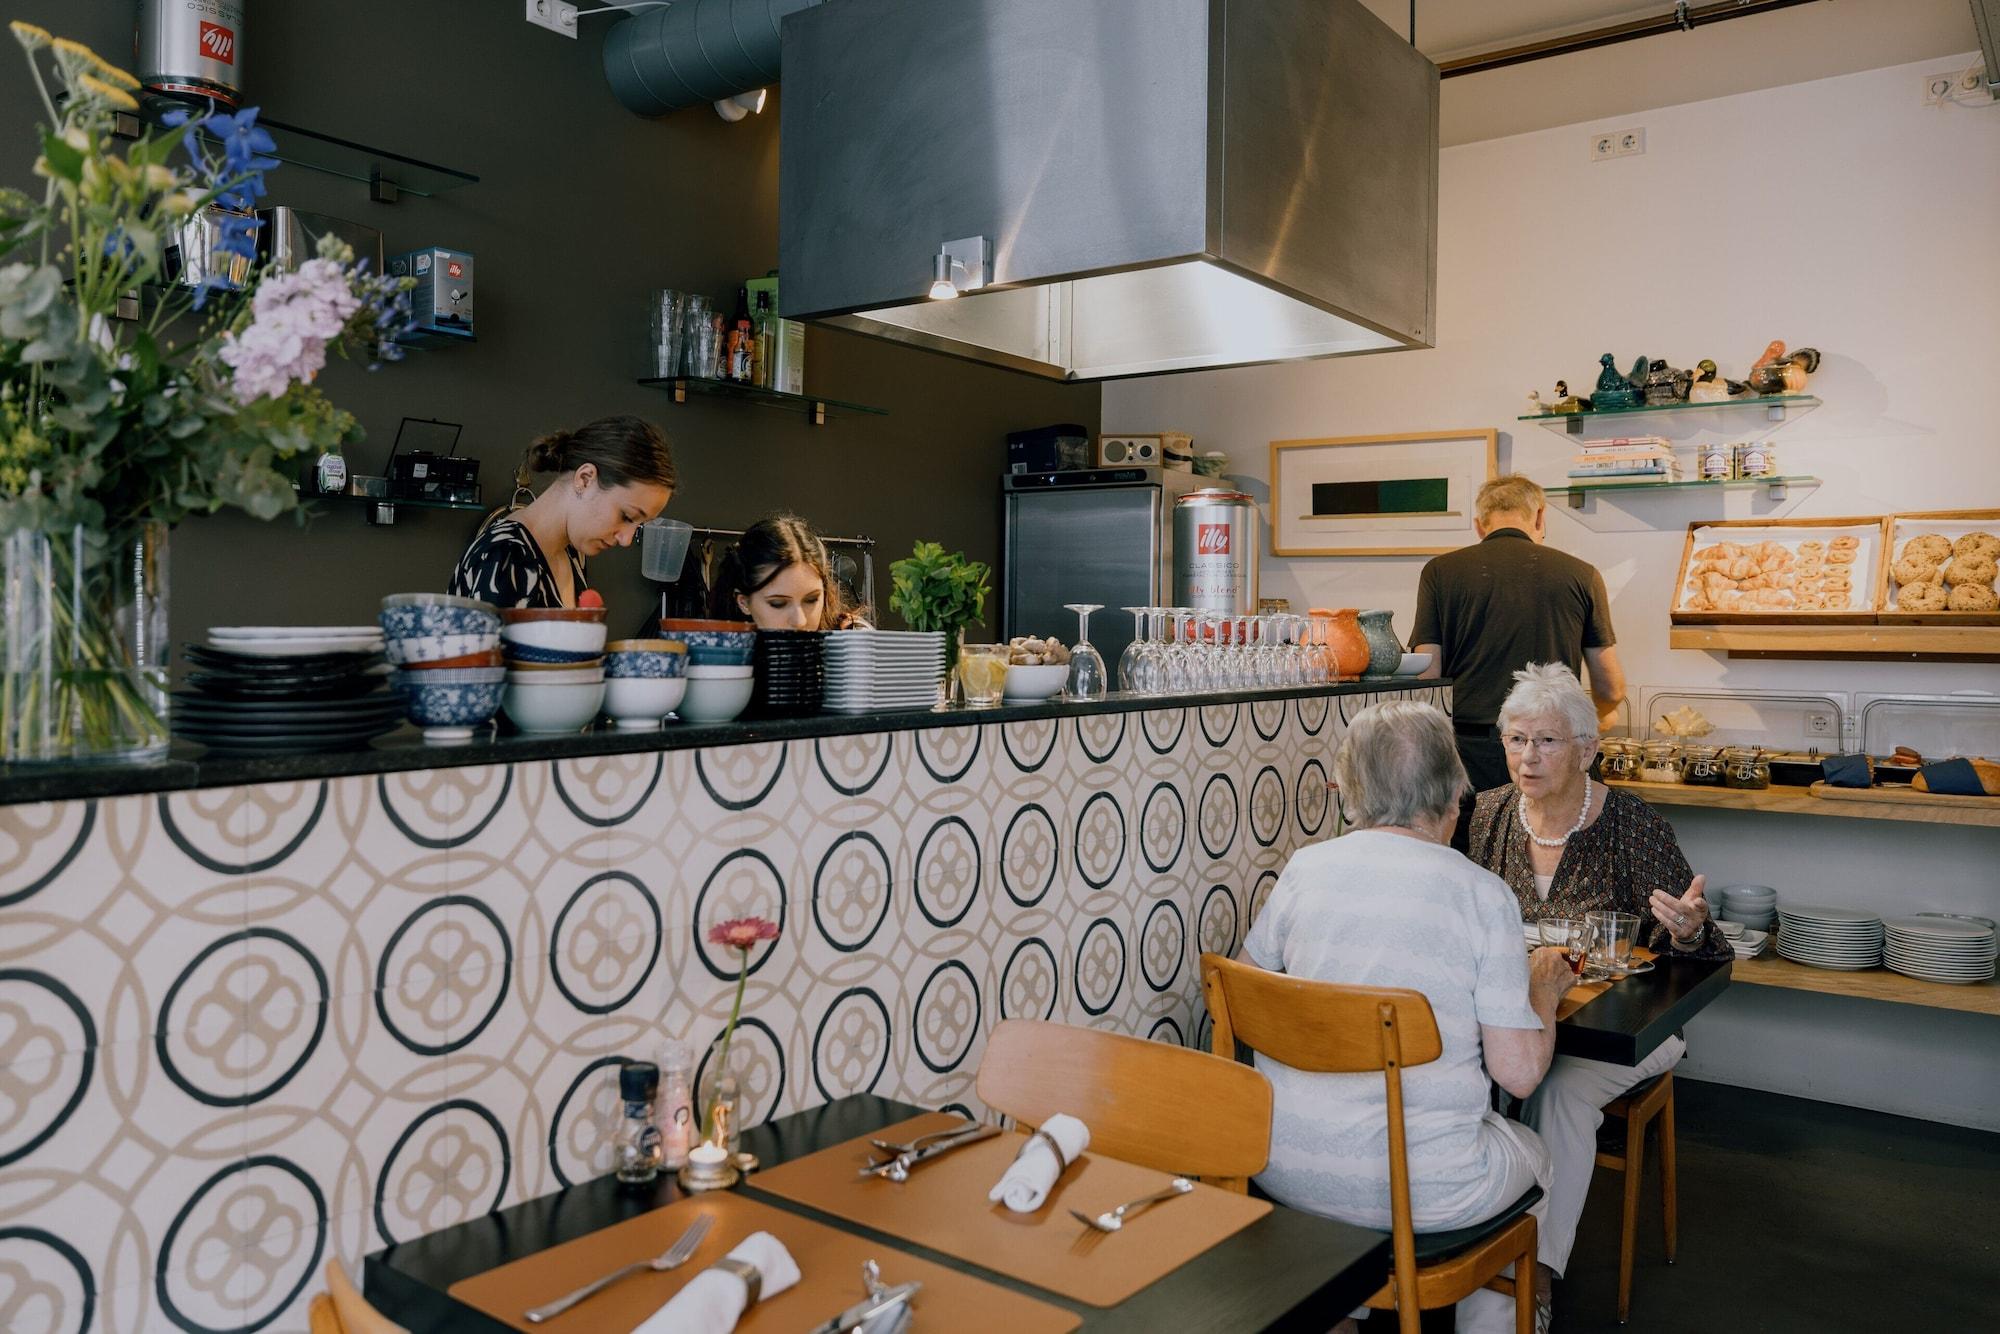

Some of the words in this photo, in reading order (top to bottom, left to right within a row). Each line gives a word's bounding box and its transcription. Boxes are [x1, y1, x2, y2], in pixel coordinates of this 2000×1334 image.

[202, 28, 232, 58] illy
[449, 264, 462, 276] illy
[1200, 528, 1228, 552] illy
